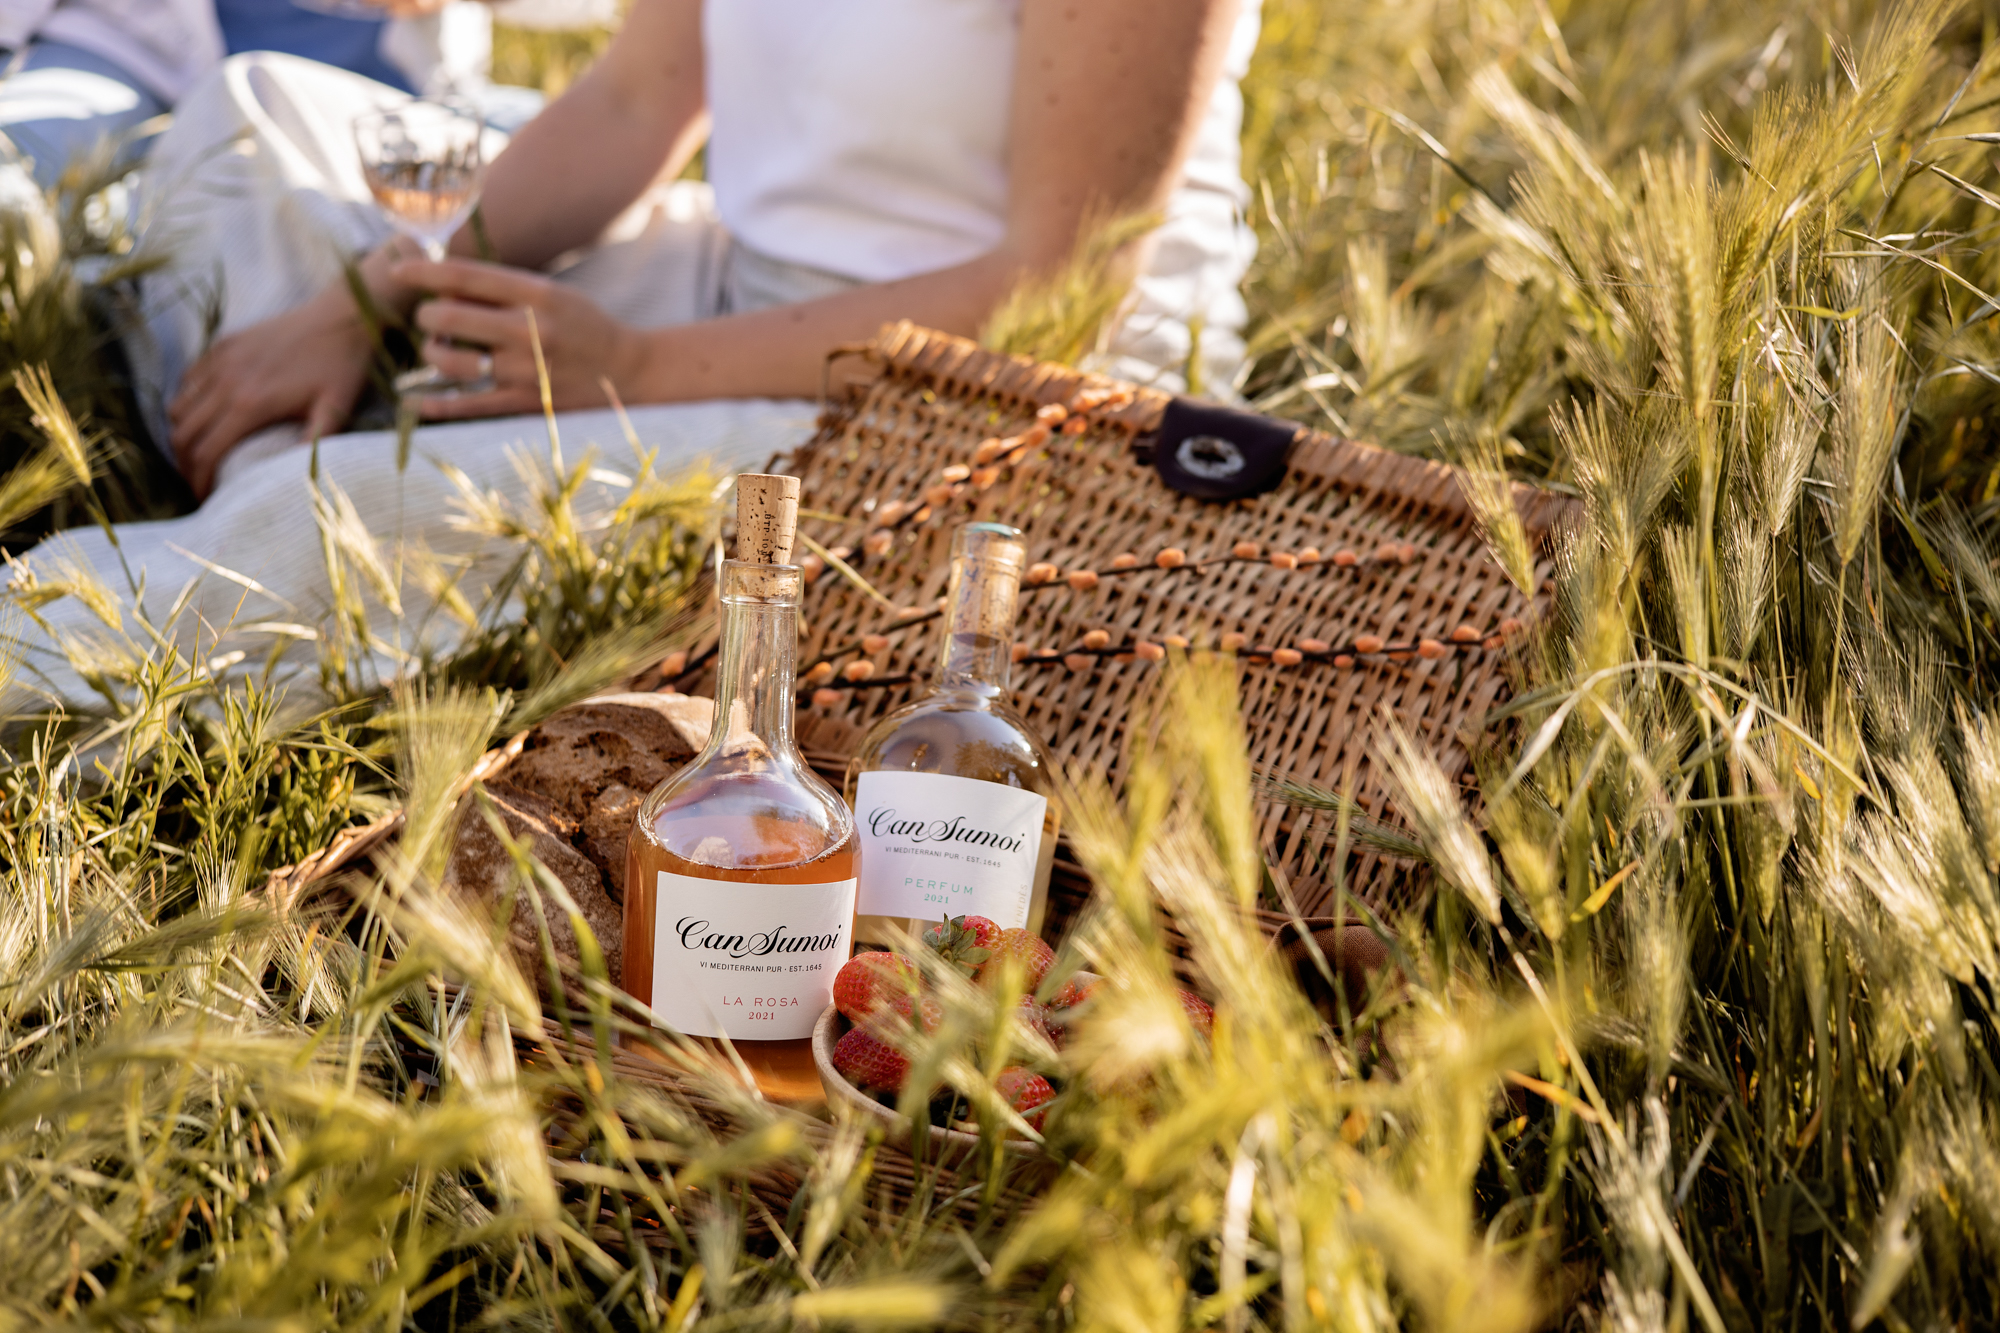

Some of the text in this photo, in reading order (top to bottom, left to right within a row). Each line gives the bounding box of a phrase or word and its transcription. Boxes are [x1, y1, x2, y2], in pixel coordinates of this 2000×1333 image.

[893, 846, 942, 857] MEDITERRANI
[944, 851, 960, 860] PUR
[904, 877, 973, 896] PERFUM
[924, 893, 949, 904] 2021
[1014, 884, 1028, 928] ENEDÈS
[709, 962, 764, 973] MEDITERRANI
[766, 965, 782, 973] PUR
[723, 995, 799, 1008] LA ROSA
[748, 1011, 775, 1020] 2021
